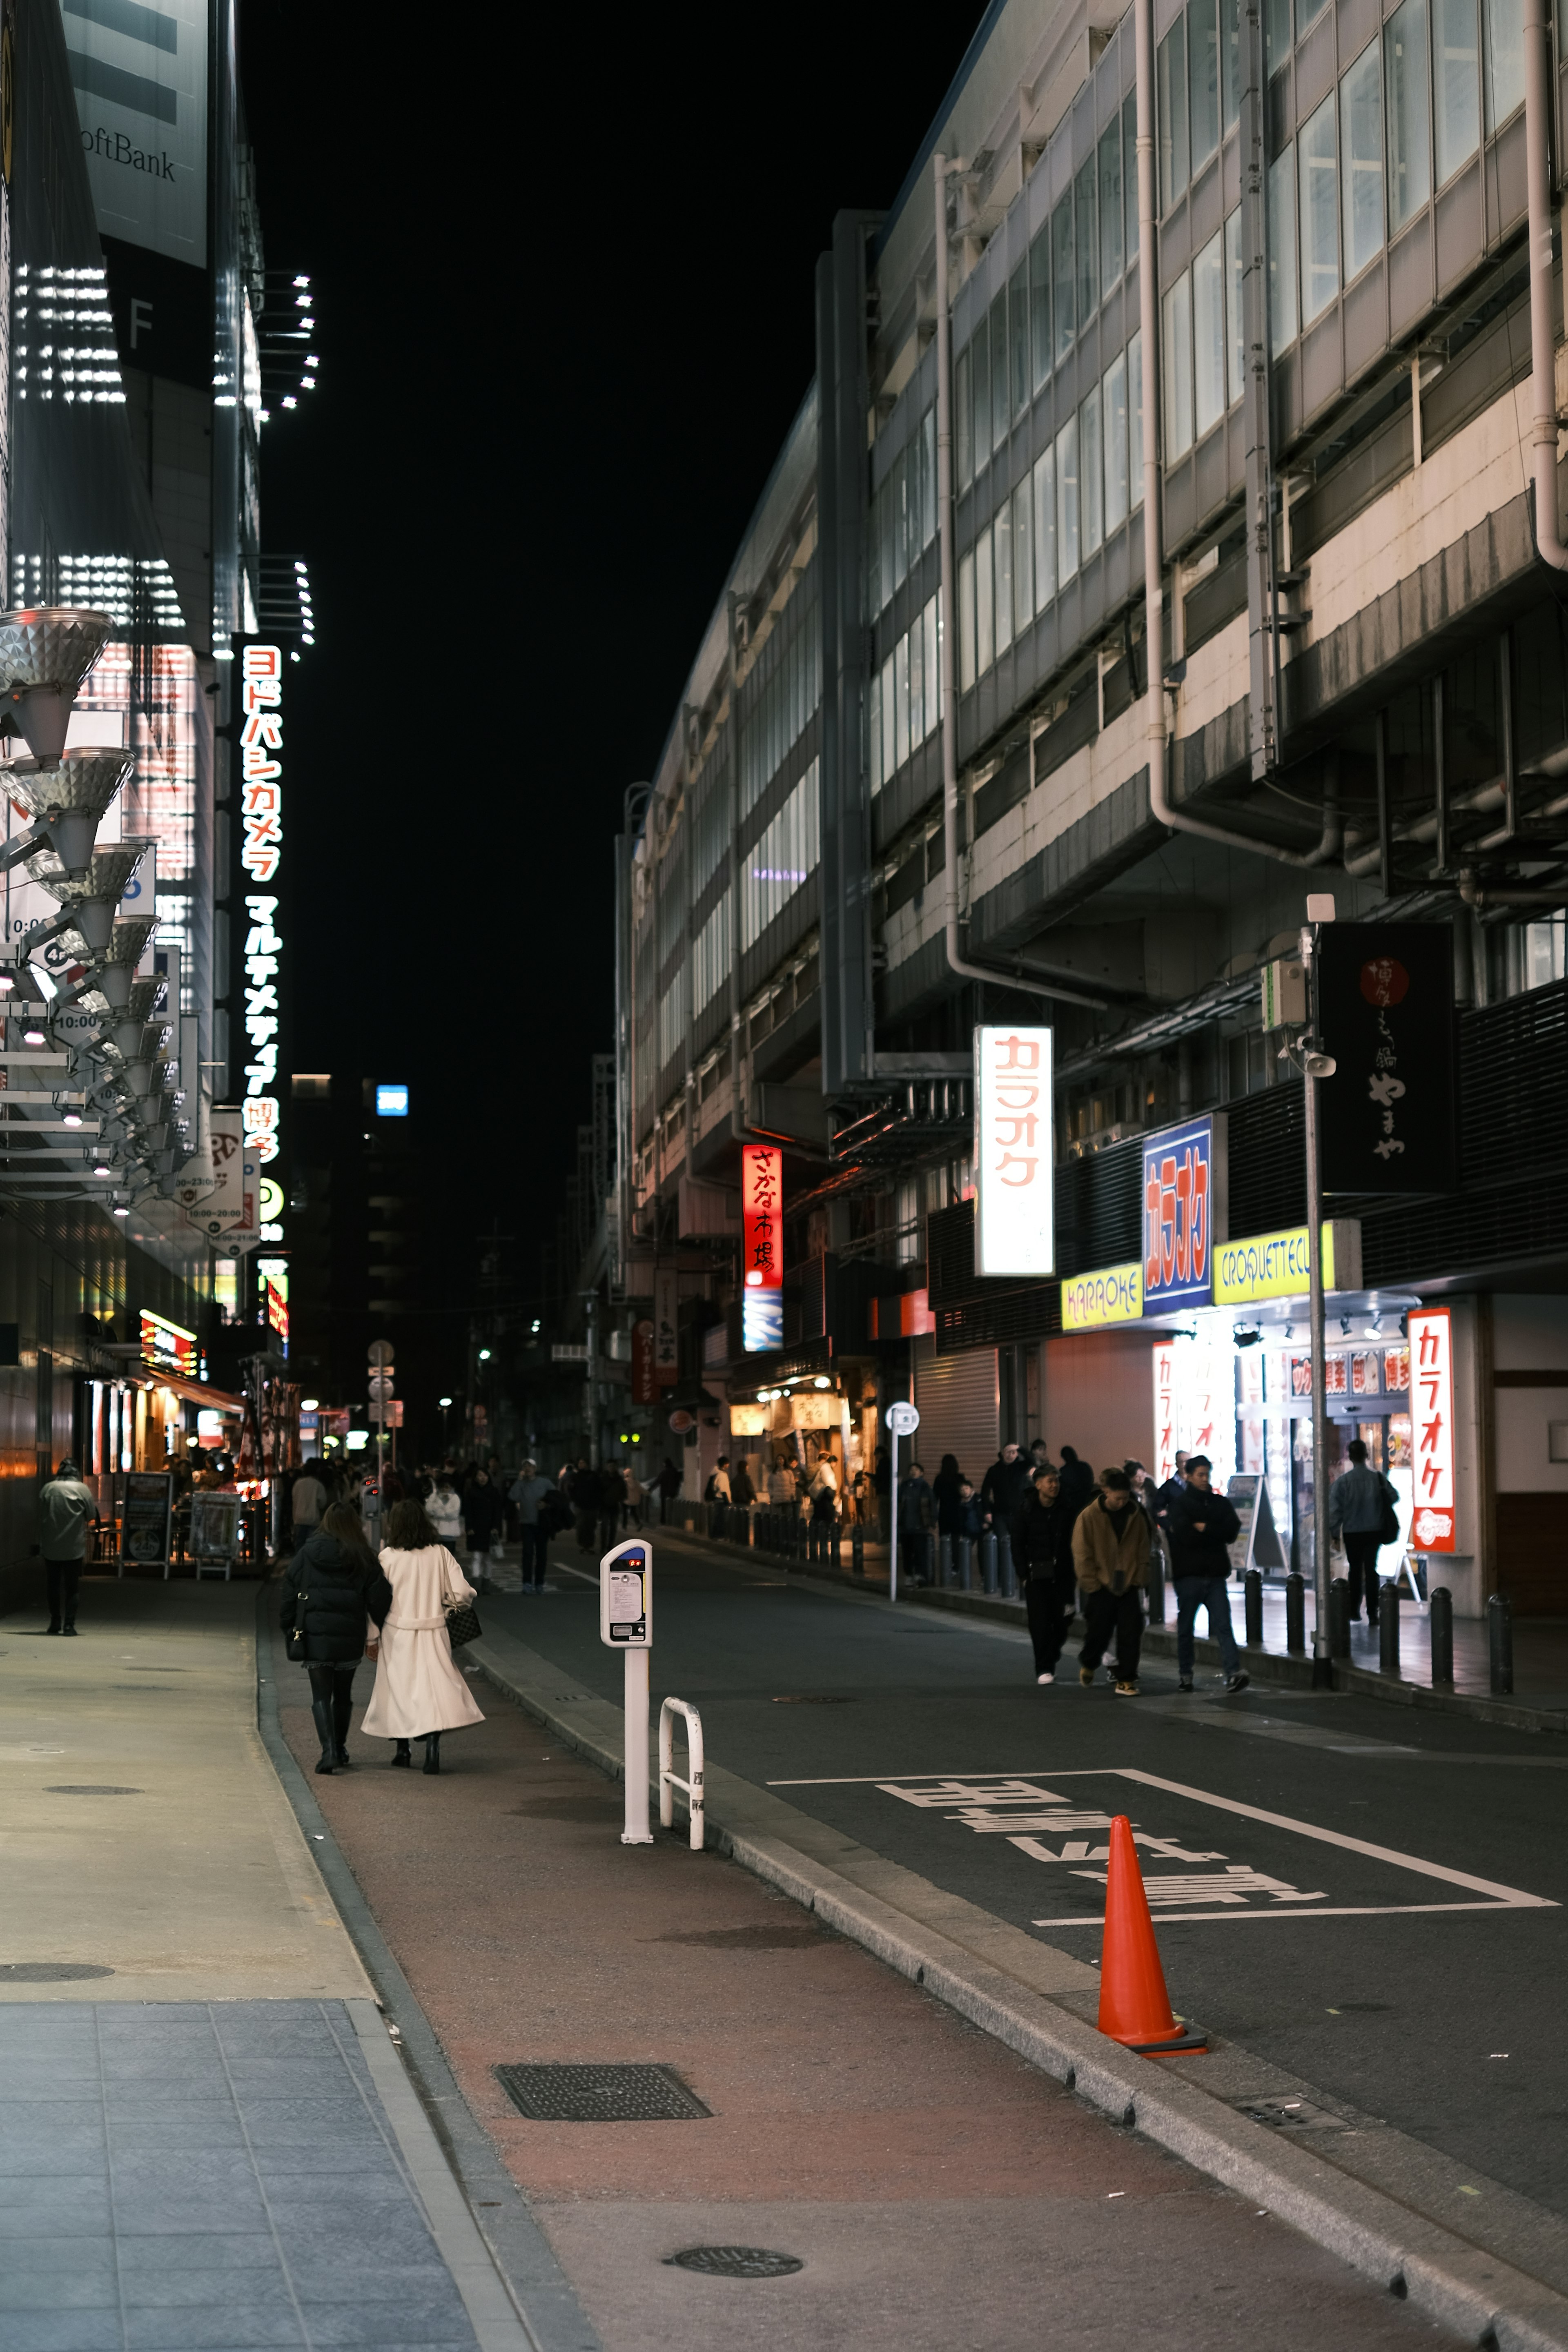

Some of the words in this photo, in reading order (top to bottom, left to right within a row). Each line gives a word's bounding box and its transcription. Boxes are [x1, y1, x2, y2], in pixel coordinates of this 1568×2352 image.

[81, 128, 176, 183] oftBank
[242, 646, 283, 881] ヨドバシカメラ
[994, 1035, 1040, 1187] カラオケ
[752, 1149, 774, 1273] さかな市場
[1146, 1146, 1209, 1290] カラオケ
[1222, 1237, 1310, 1293] CROQUETTECL
[1067, 1271, 1137, 1322] KARAOKE
[1419, 1325, 1443, 1499] カラオケ
